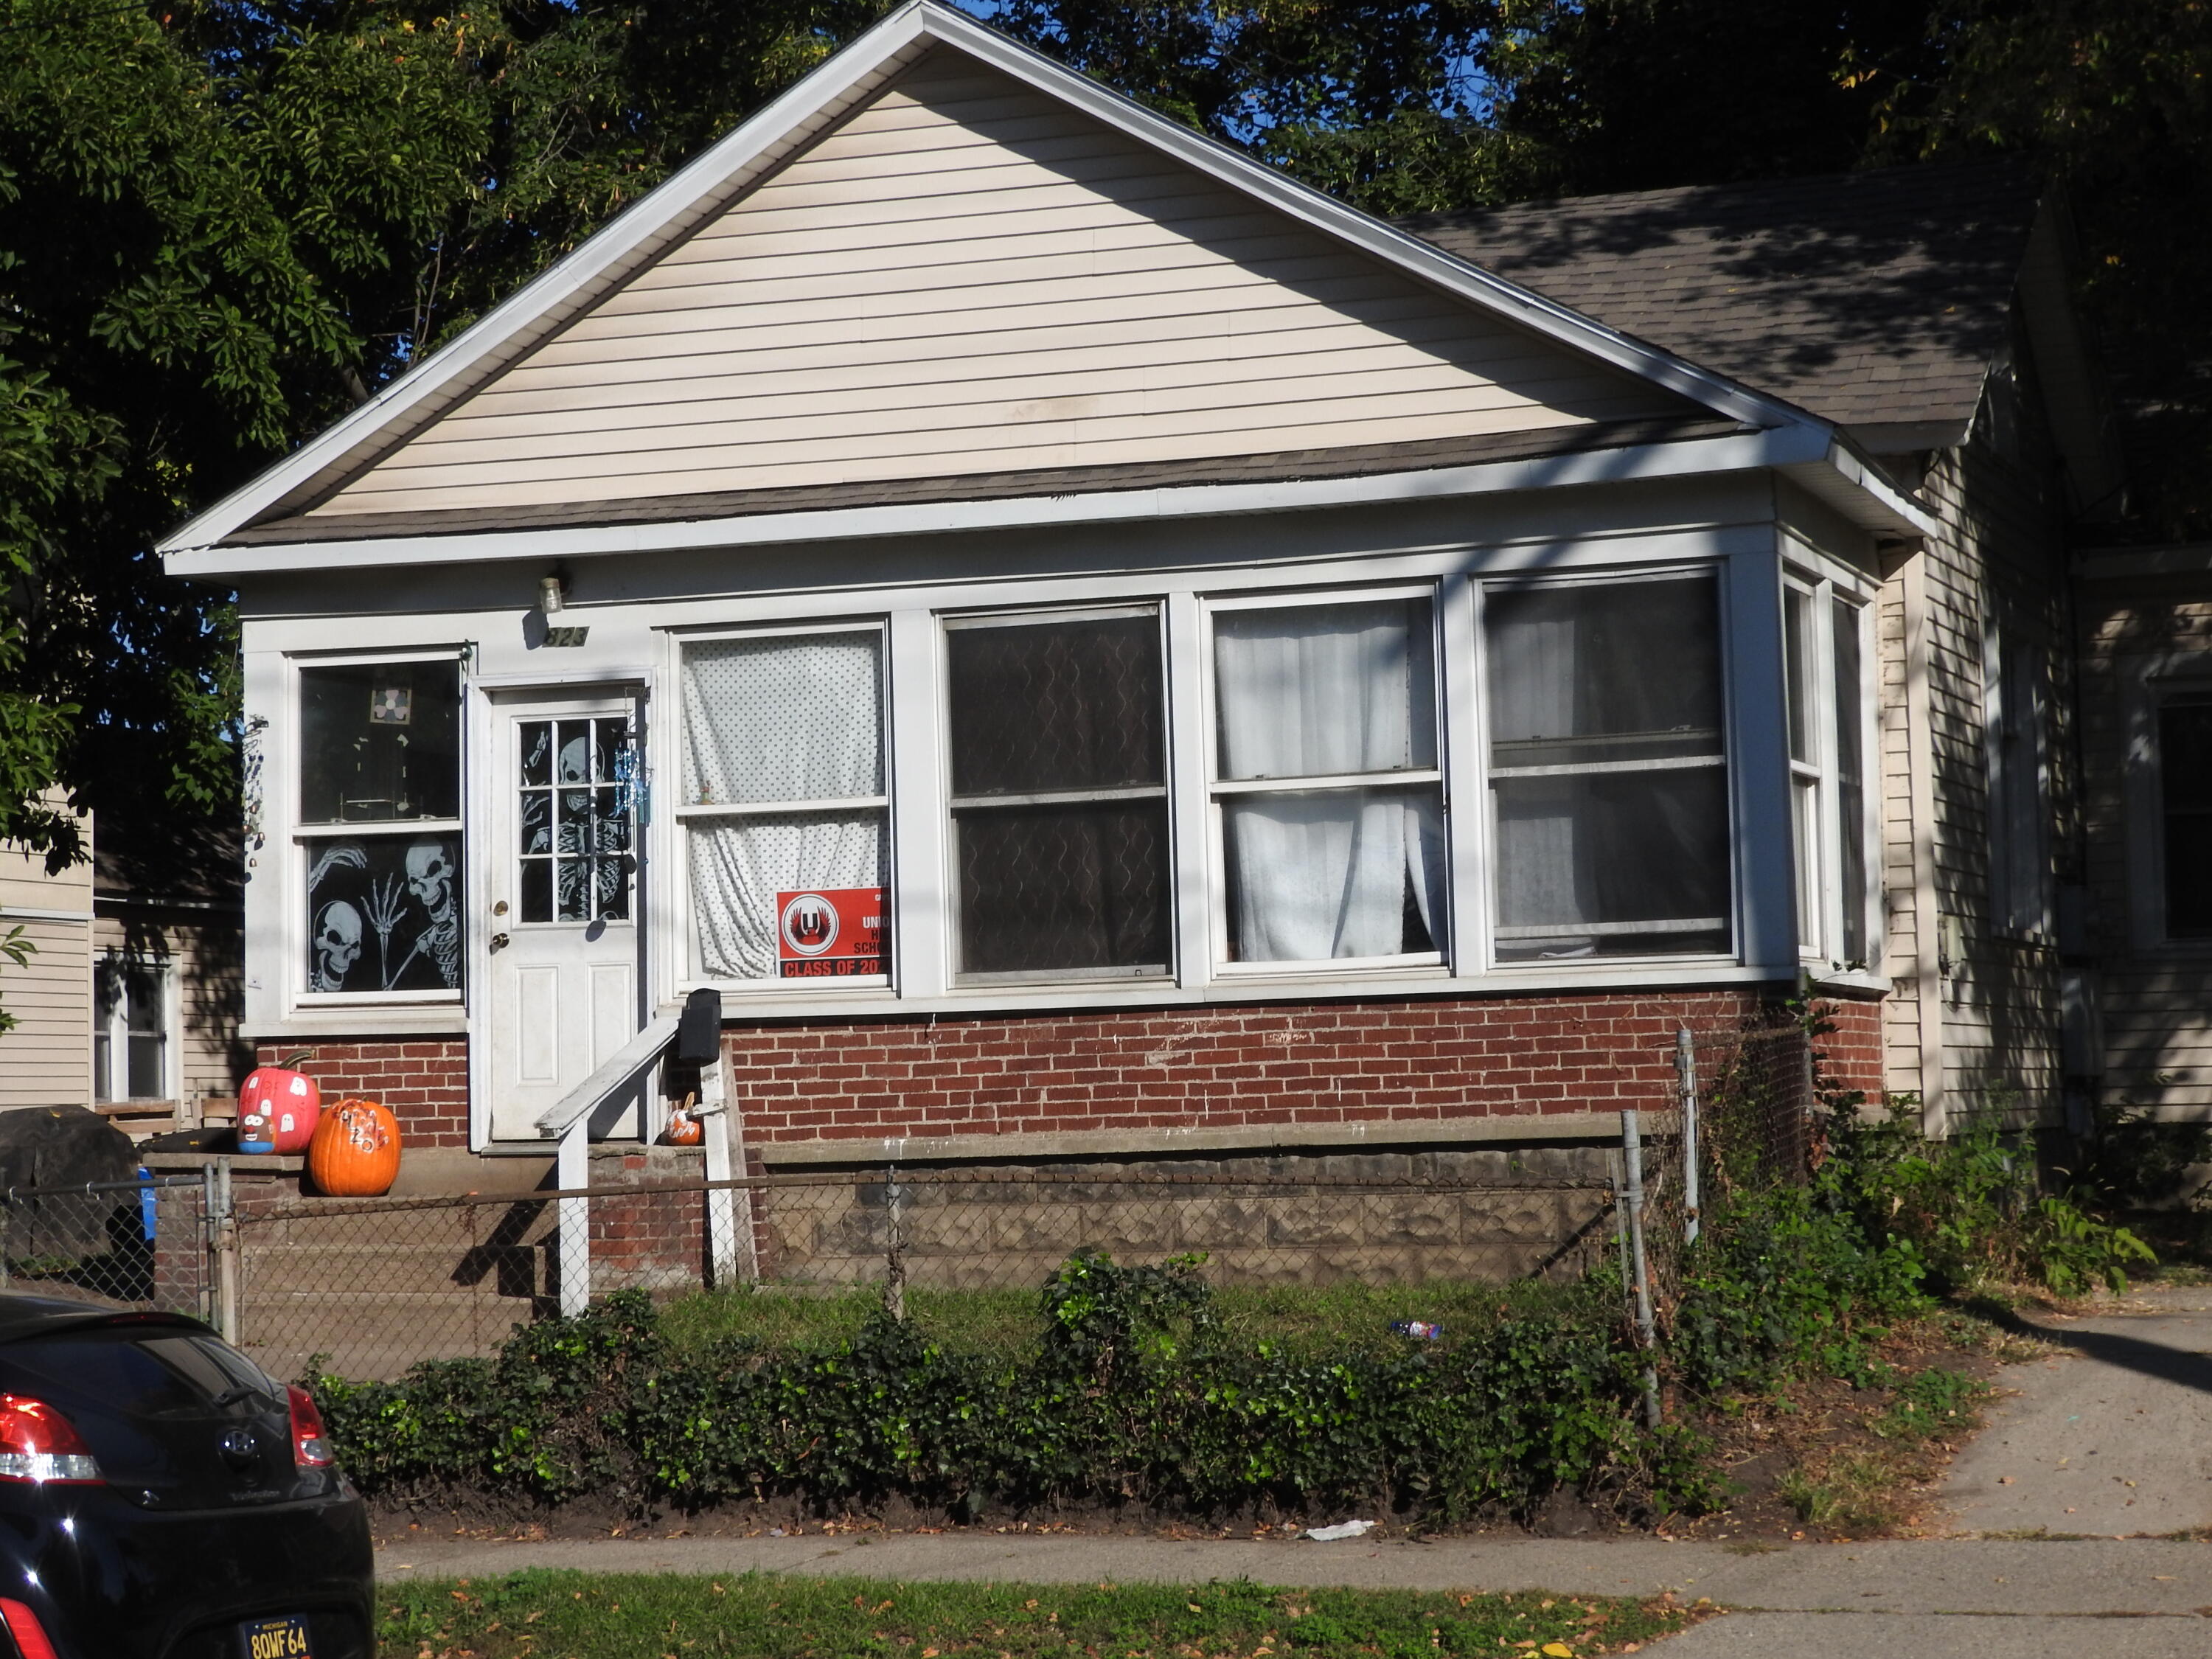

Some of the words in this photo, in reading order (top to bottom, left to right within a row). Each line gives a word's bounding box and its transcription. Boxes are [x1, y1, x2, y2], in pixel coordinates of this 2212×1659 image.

[545, 627, 588, 647] 823
[863, 916, 890, 929] UNIO
[785, 961, 832, 978] CLASS
[836, 960, 855, 975] OF
[860, 959, 880, 975] 20
